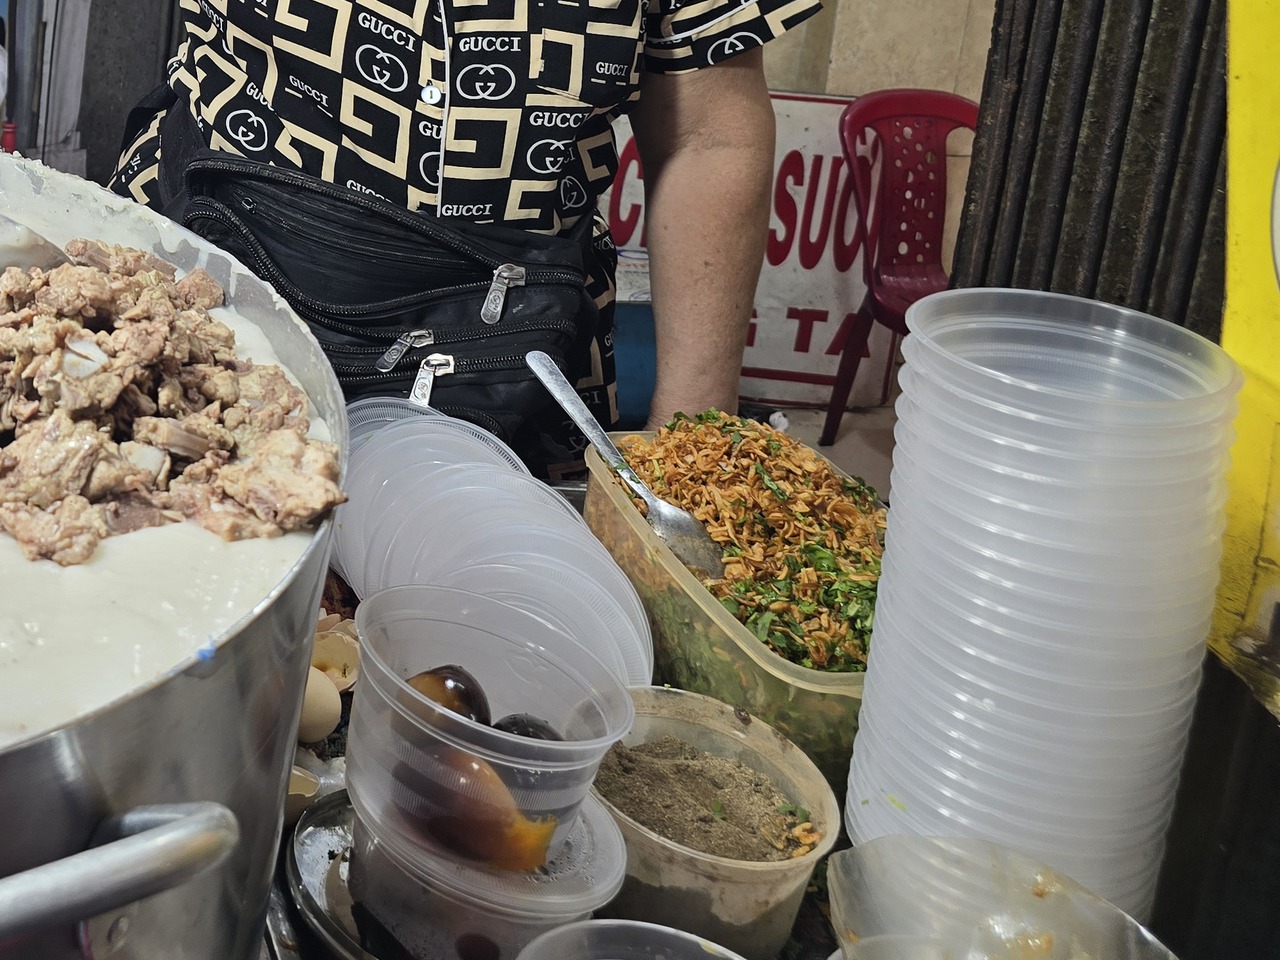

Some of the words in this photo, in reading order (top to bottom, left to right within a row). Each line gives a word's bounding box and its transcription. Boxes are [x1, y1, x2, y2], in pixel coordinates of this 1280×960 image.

[358, 11, 416, 52] GUCCI
[459, 37, 521, 52] GUCCI
[595, 61, 628, 77] GUCCI
[289, 74, 329, 107] GUCCI
[442, 203, 494, 216] GUCCI
